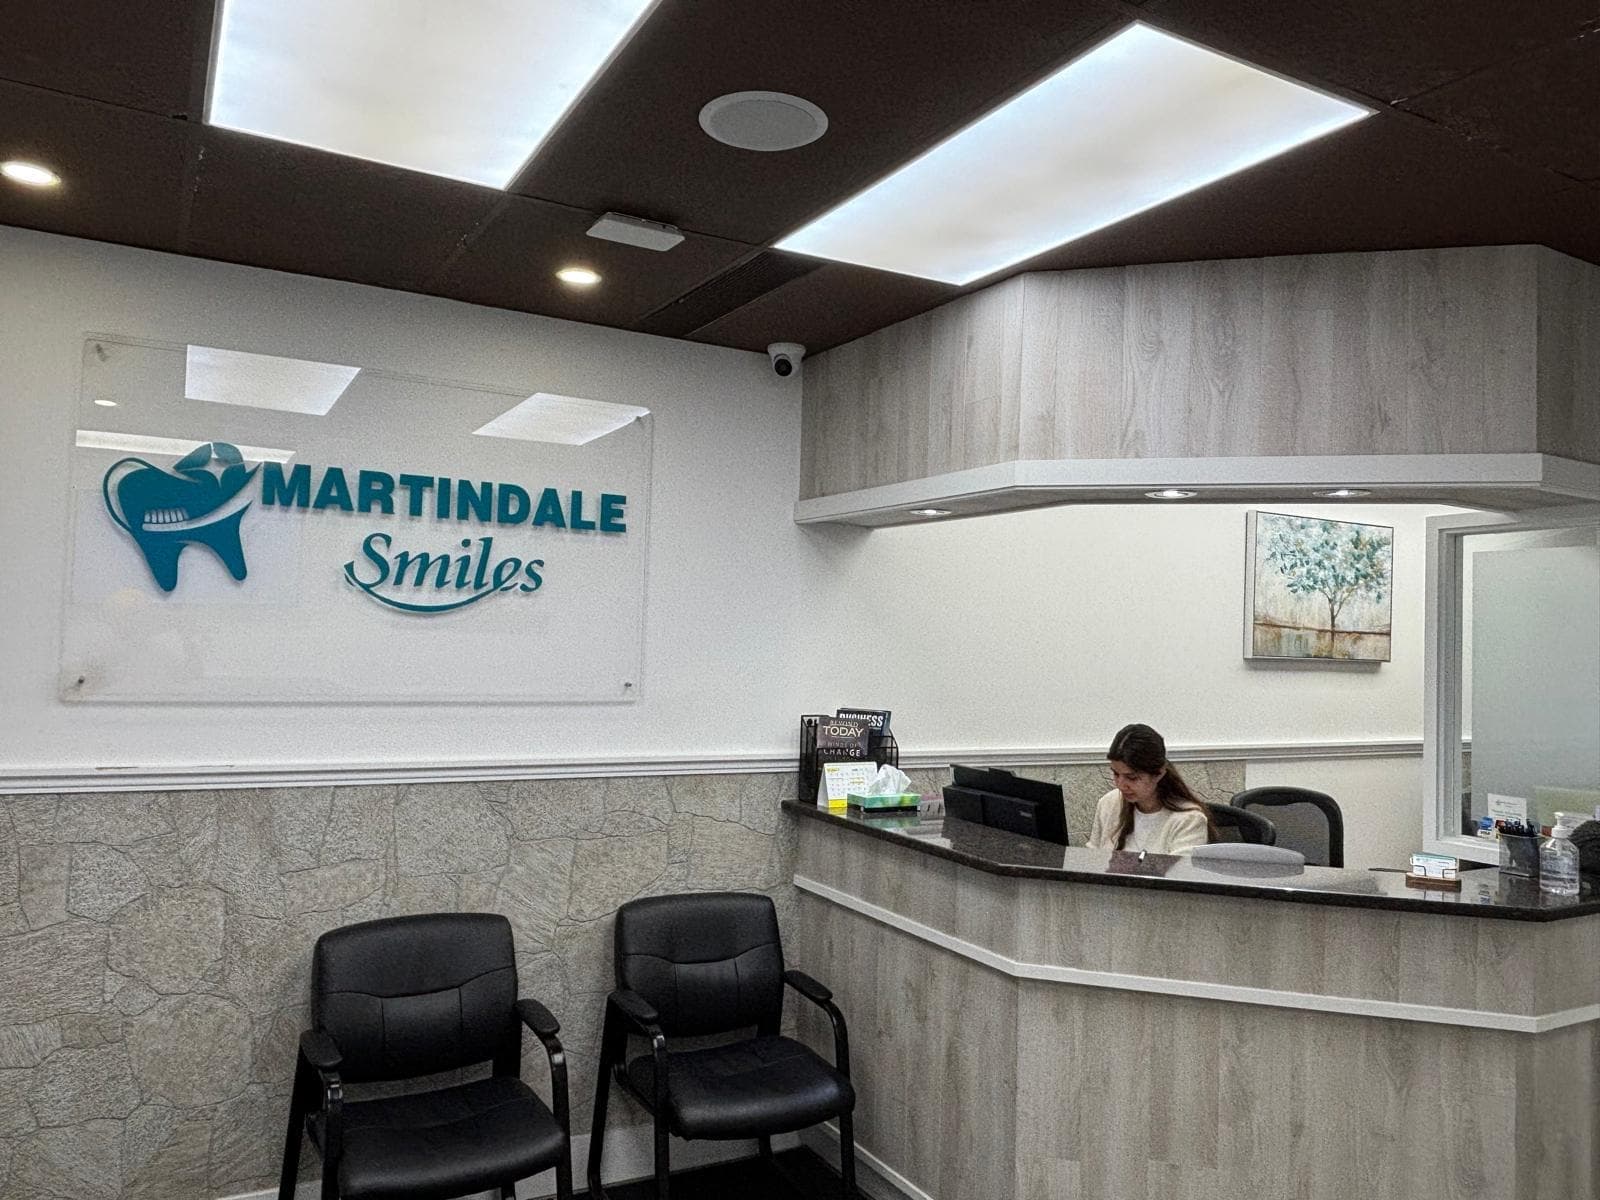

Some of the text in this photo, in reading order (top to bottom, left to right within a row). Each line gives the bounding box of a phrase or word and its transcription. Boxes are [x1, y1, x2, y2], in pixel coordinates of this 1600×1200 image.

[261, 463, 626, 533] MARTINDALE
[344, 532, 545, 613] Smiles
[822, 725, 865, 737] TODAY
[823, 748, 861, 757] CHANGE
